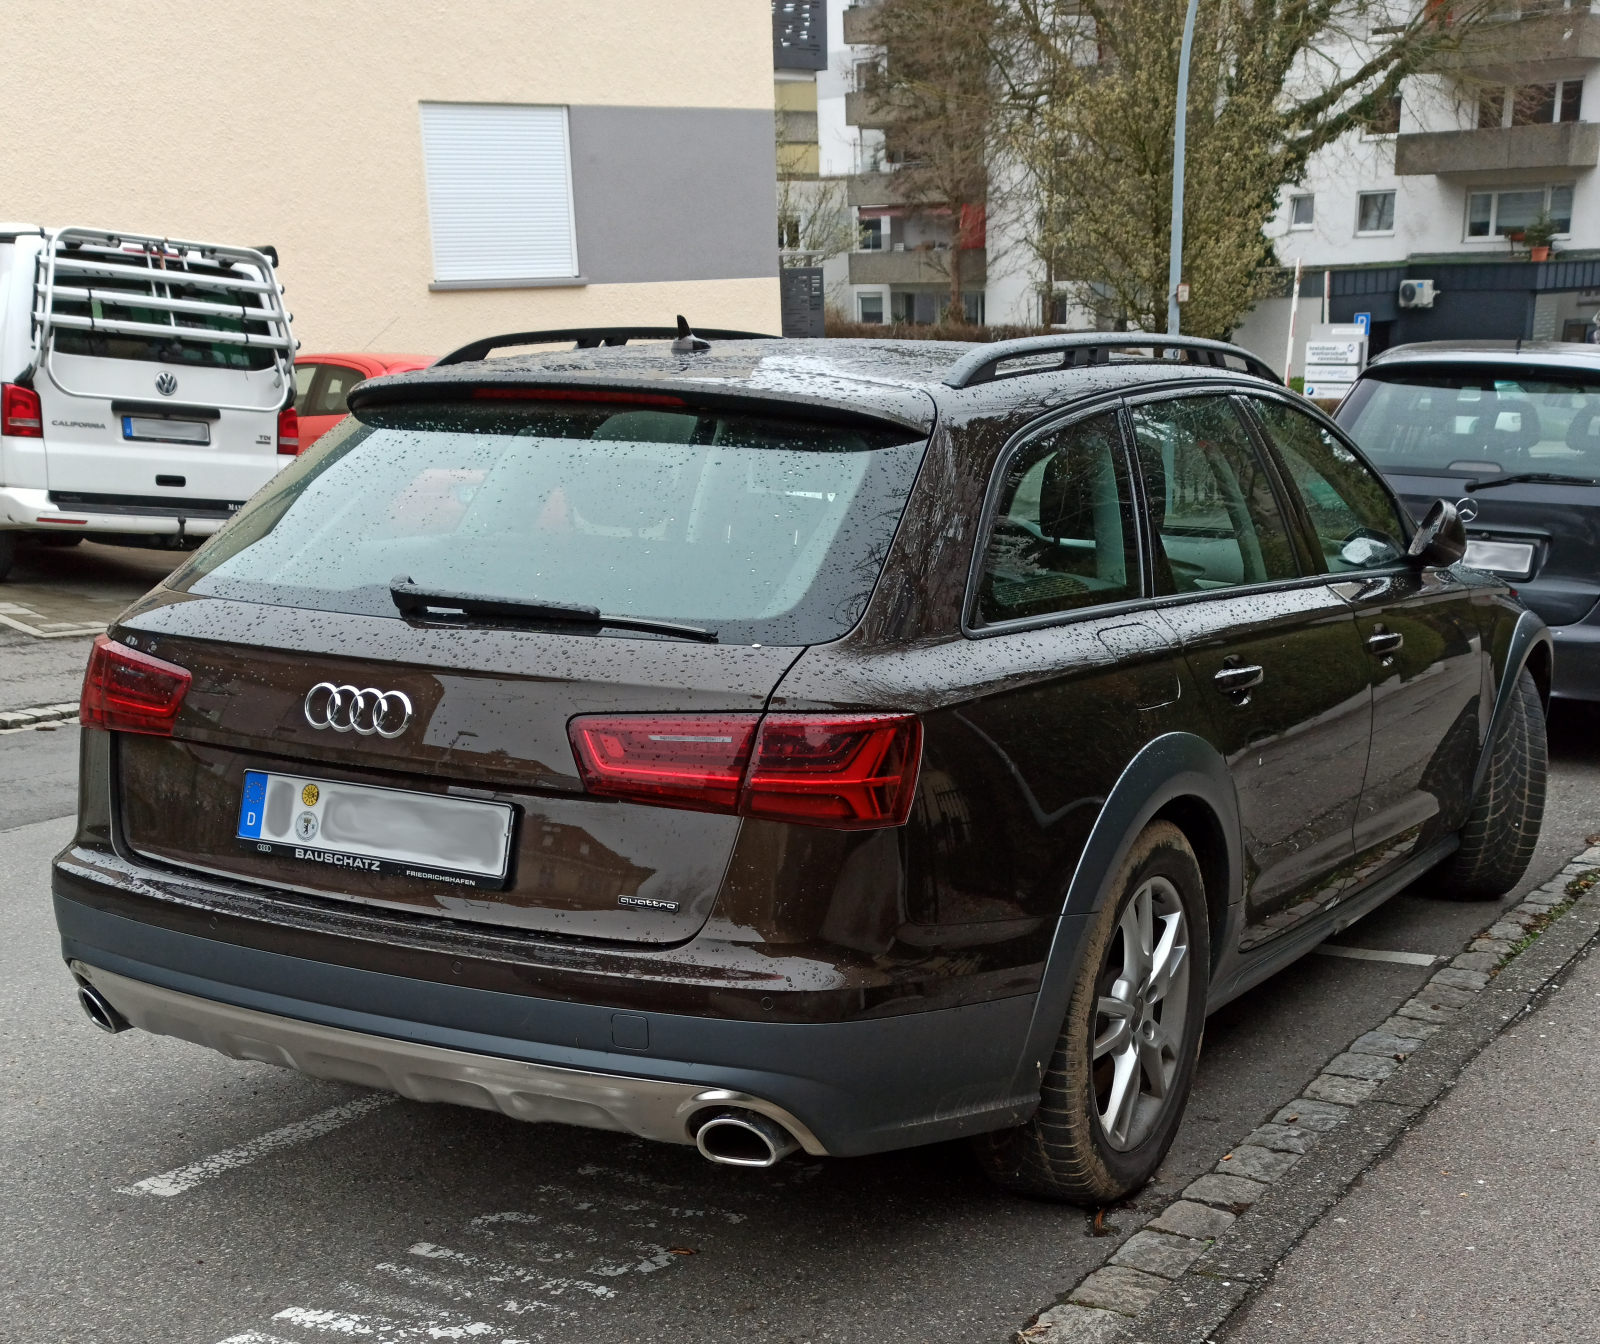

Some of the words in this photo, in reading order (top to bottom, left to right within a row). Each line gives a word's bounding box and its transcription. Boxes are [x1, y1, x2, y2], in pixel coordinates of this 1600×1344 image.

[51, 420, 106, 429] CALIFORNIA
[247, 812, 255, 825] D
[295, 848, 380, 871] BAUSCHATZ
[406, 870, 476, 886] FRIEDRICHSHAFEN
[620, 897, 675, 909] quattro
